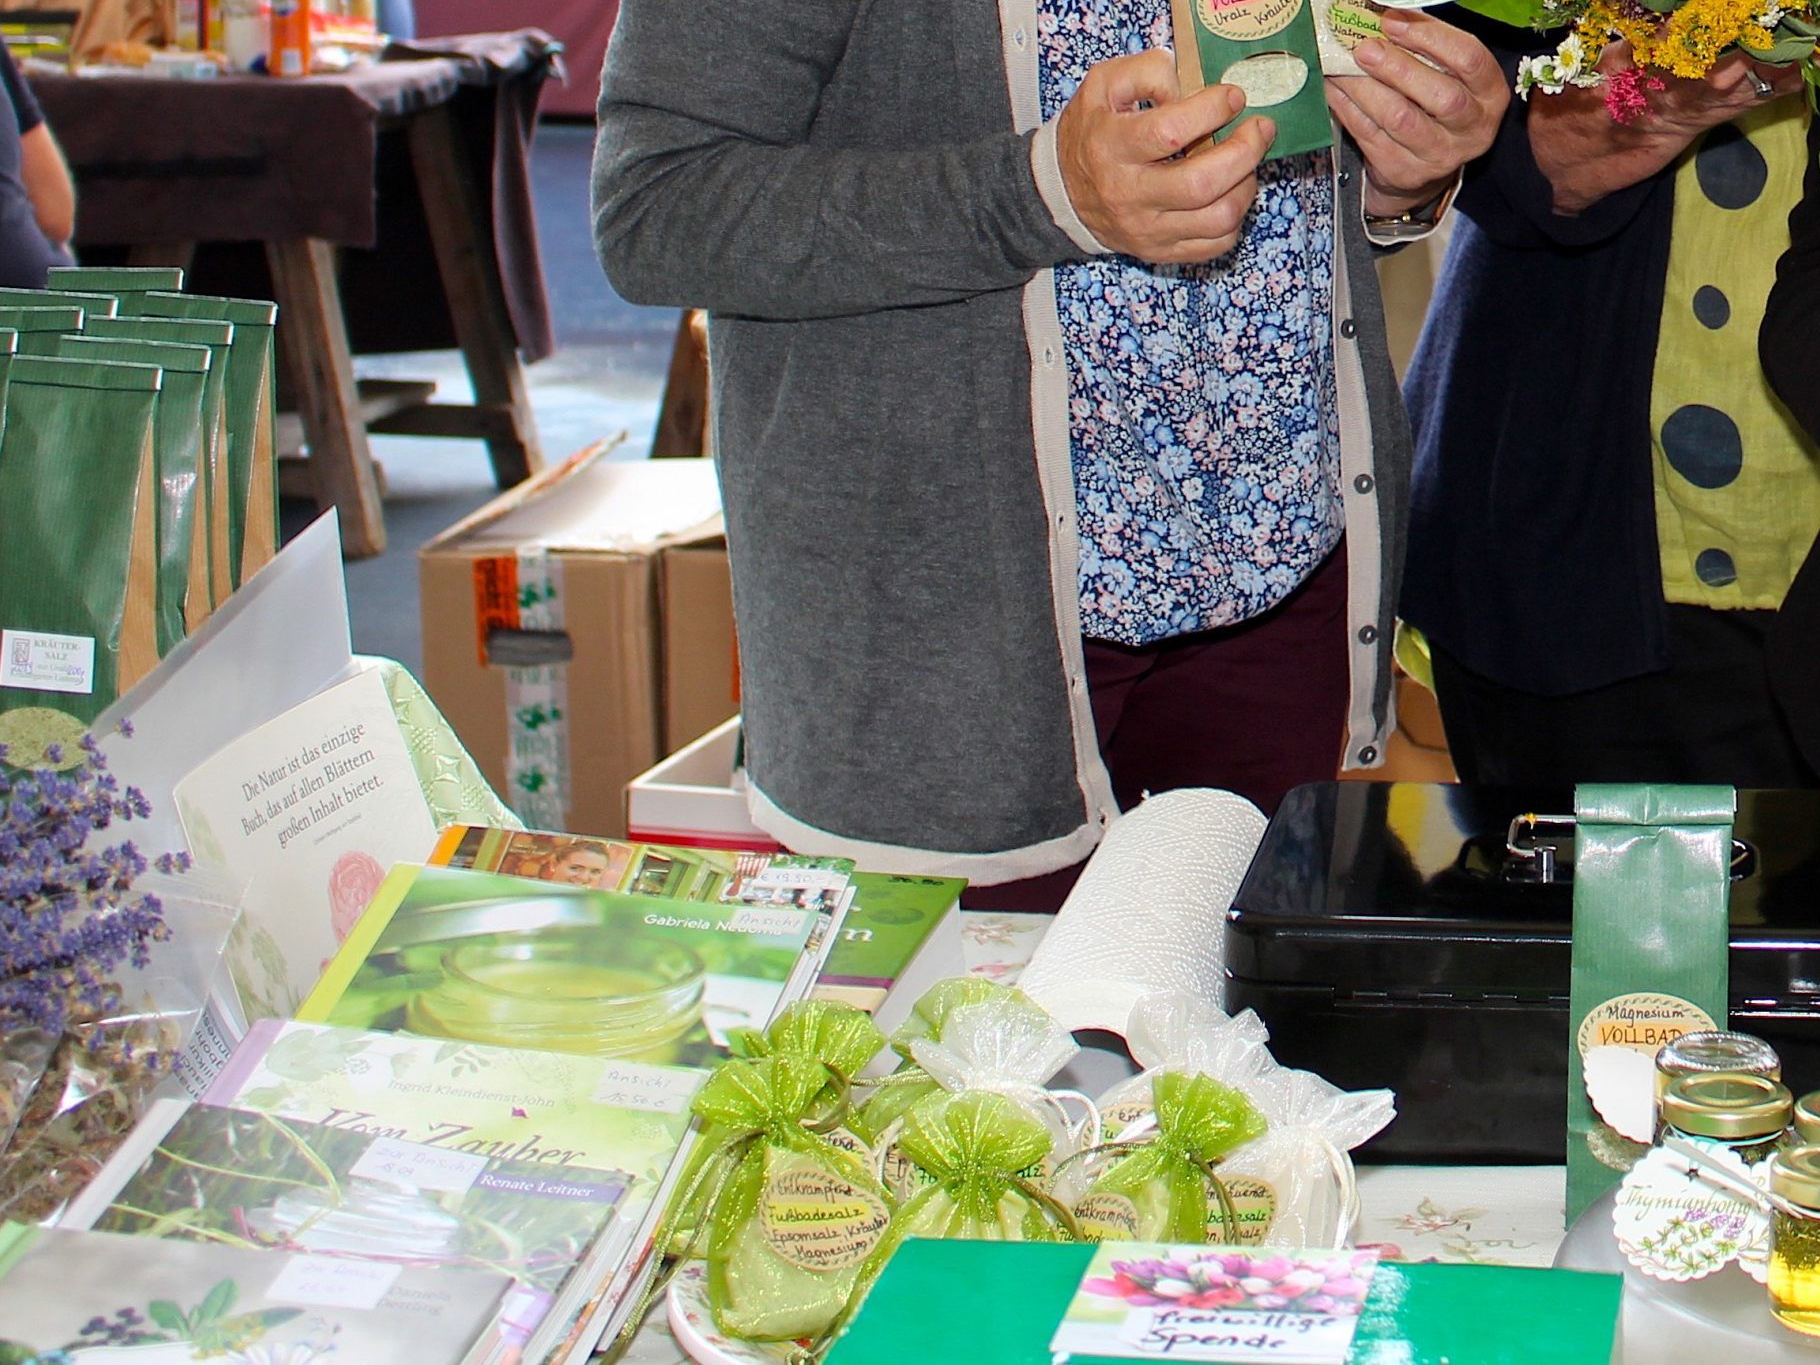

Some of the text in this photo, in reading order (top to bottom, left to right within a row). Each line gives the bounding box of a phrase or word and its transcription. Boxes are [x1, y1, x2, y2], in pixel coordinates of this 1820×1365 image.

[1330, 24, 1367, 40] Natro
[241, 723, 366, 802] Die Natur ist das einzige
[240, 748, 376, 837] Buch, das auf allen Blättern
[277, 815, 312, 850] großen
[308, 791, 346, 824] Inhalt
[341, 774, 385, 804] bietet.
[643, 913, 712, 931] Gabriela
[1604, 1004, 1685, 1028] Magnesium
[387, 1081, 556, 1108] Ingrid Kleindienst-John
[421, 1121, 587, 1166] Zauber
[480, 1174, 595, 1198] Renate Leitner
[767, 1204, 865, 1227] Fußbadesalz
[847, 1216, 889, 1238] Kräuter
[794, 1239, 868, 1263] Magnesium
[1139, 1326, 1288, 1353] Spende
